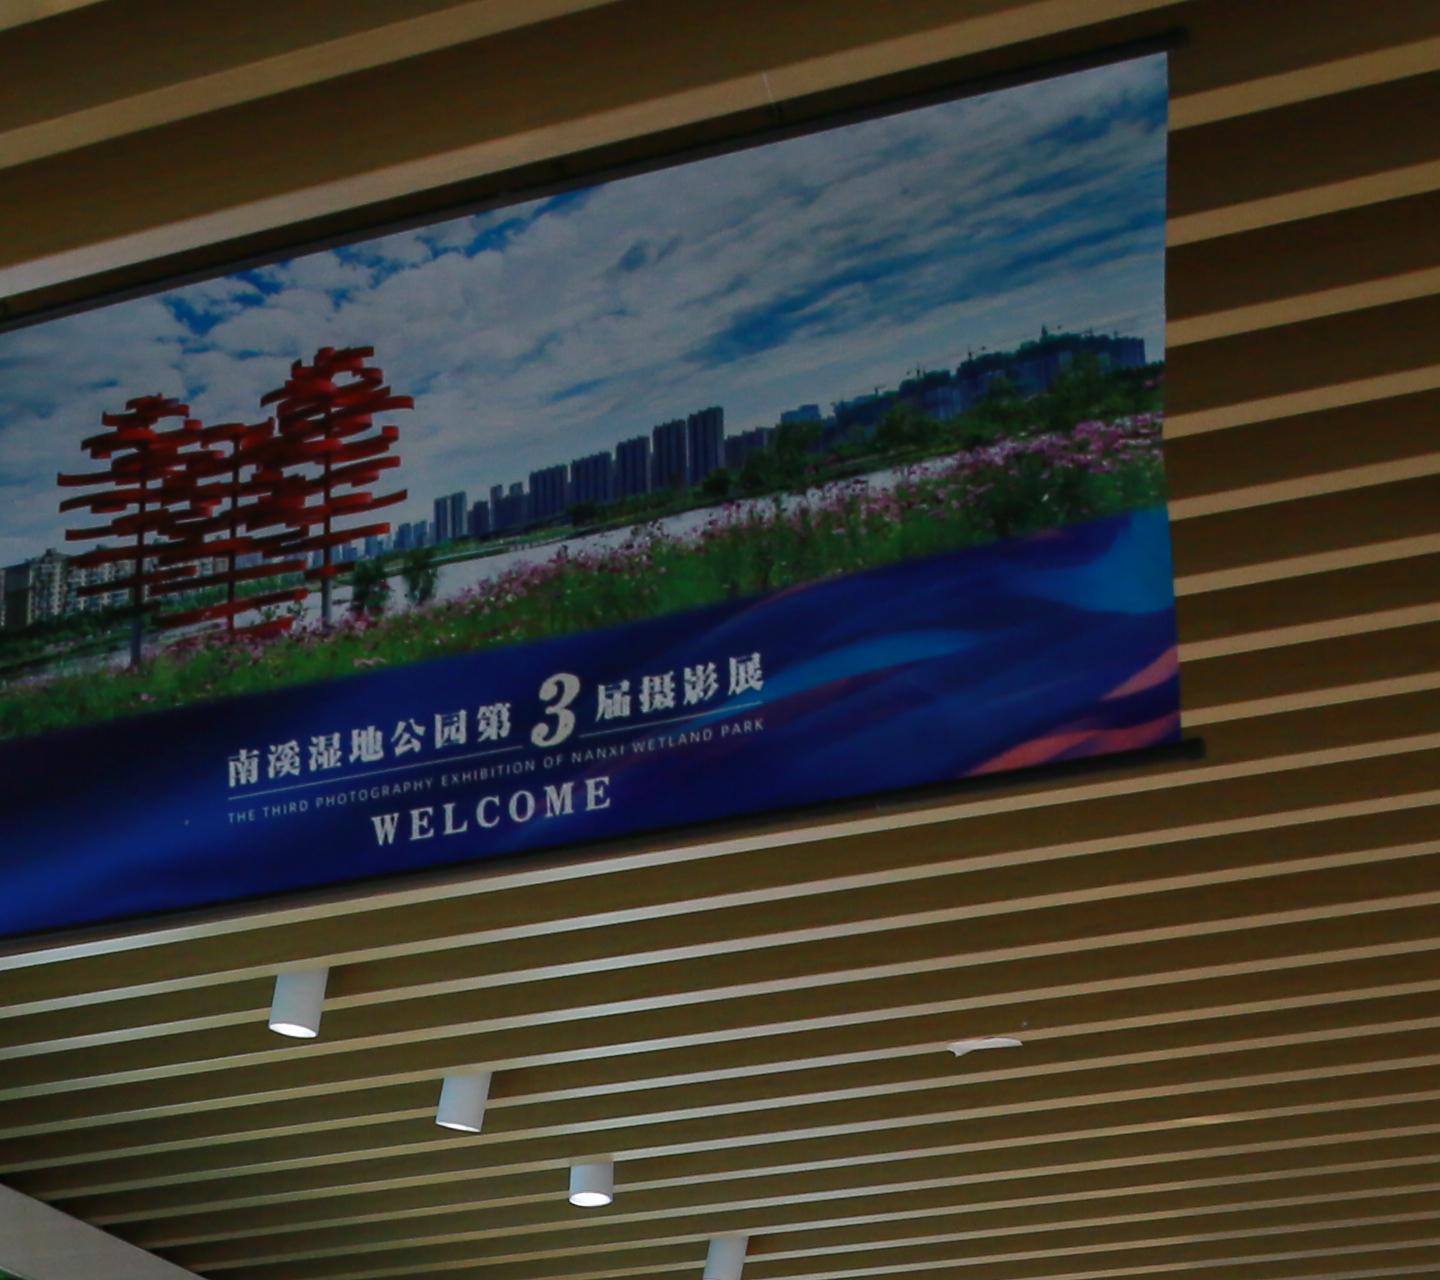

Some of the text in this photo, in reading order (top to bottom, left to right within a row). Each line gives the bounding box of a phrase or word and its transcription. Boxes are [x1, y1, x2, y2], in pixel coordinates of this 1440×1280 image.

[227, 652, 765, 788] 南溪湿地公园第3届摄影展
[227, 717, 765, 825] THE THIRD PHOTOGRAPHY EXHIBITION OF NANXI WETLAND PARK
[370, 775, 611, 847] WELCOME
